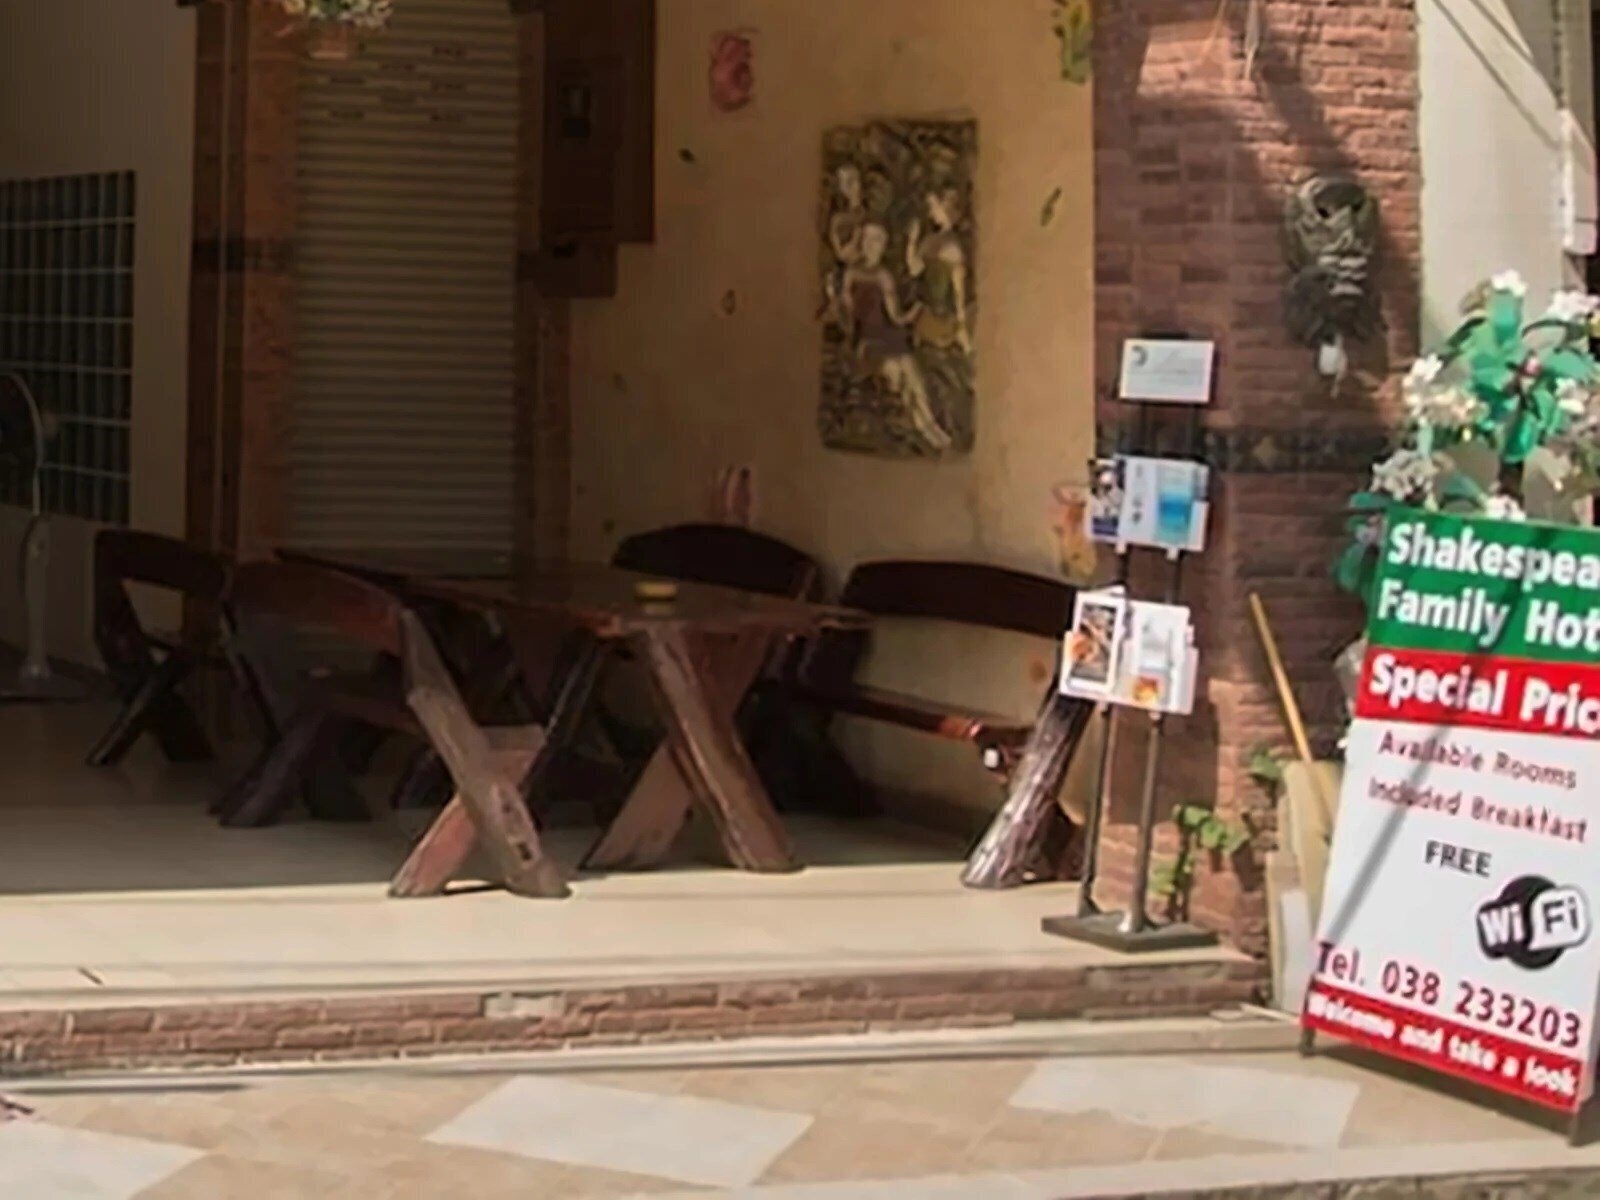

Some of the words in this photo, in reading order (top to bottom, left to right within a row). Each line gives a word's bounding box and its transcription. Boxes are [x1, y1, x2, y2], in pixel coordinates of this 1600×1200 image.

[1388, 522, 1600, 592] Shakespea
[1377, 578, 1511, 647] Family
[1369, 653, 1509, 715] Special
[1378, 730, 1484, 772] Available
[1492, 751, 1578, 790] Rooms
[1368, 776, 1463, 817] Included
[1470, 796, 1588, 843] Breakfast
[1424, 839, 1492, 878] FREE
[1318, 941, 1366, 987] Tel.
[1381, 960, 1441, 1005] 038
[1455, 980, 1581, 1048] 233203
[1308, 992, 1396, 1040] Welcome
[1400, 1022, 1444, 1053] and
[1448, 1034, 1497, 1071] take
[1501, 1056, 1520, 1077] a
[1522, 1055, 1577, 1097] look
